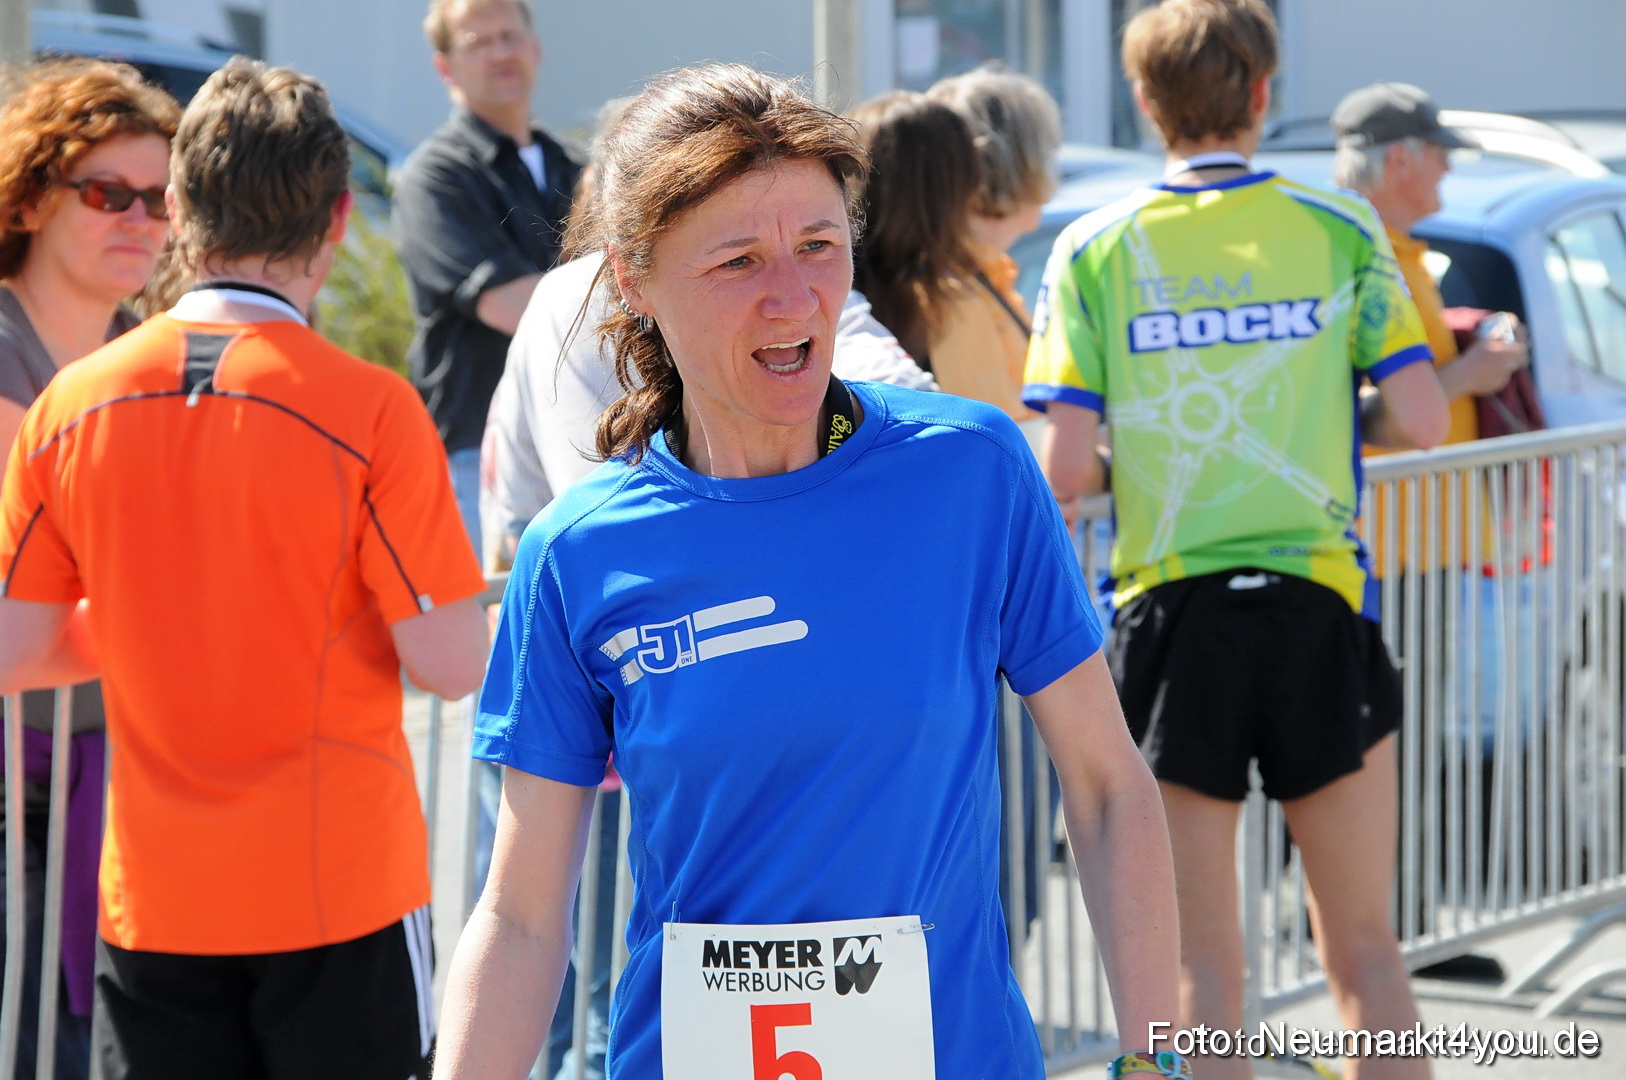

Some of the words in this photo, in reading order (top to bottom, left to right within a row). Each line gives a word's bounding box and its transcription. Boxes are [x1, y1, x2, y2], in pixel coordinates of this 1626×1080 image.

[1132, 271, 1253, 304] TEAM
[1128, 297, 1322, 353] BOCK
[681, 655, 693, 665] ONE
[702, 939, 824, 969] MEYER
[702, 971, 826, 992] WERBUNG
[750, 1002, 823, 1080] 5
